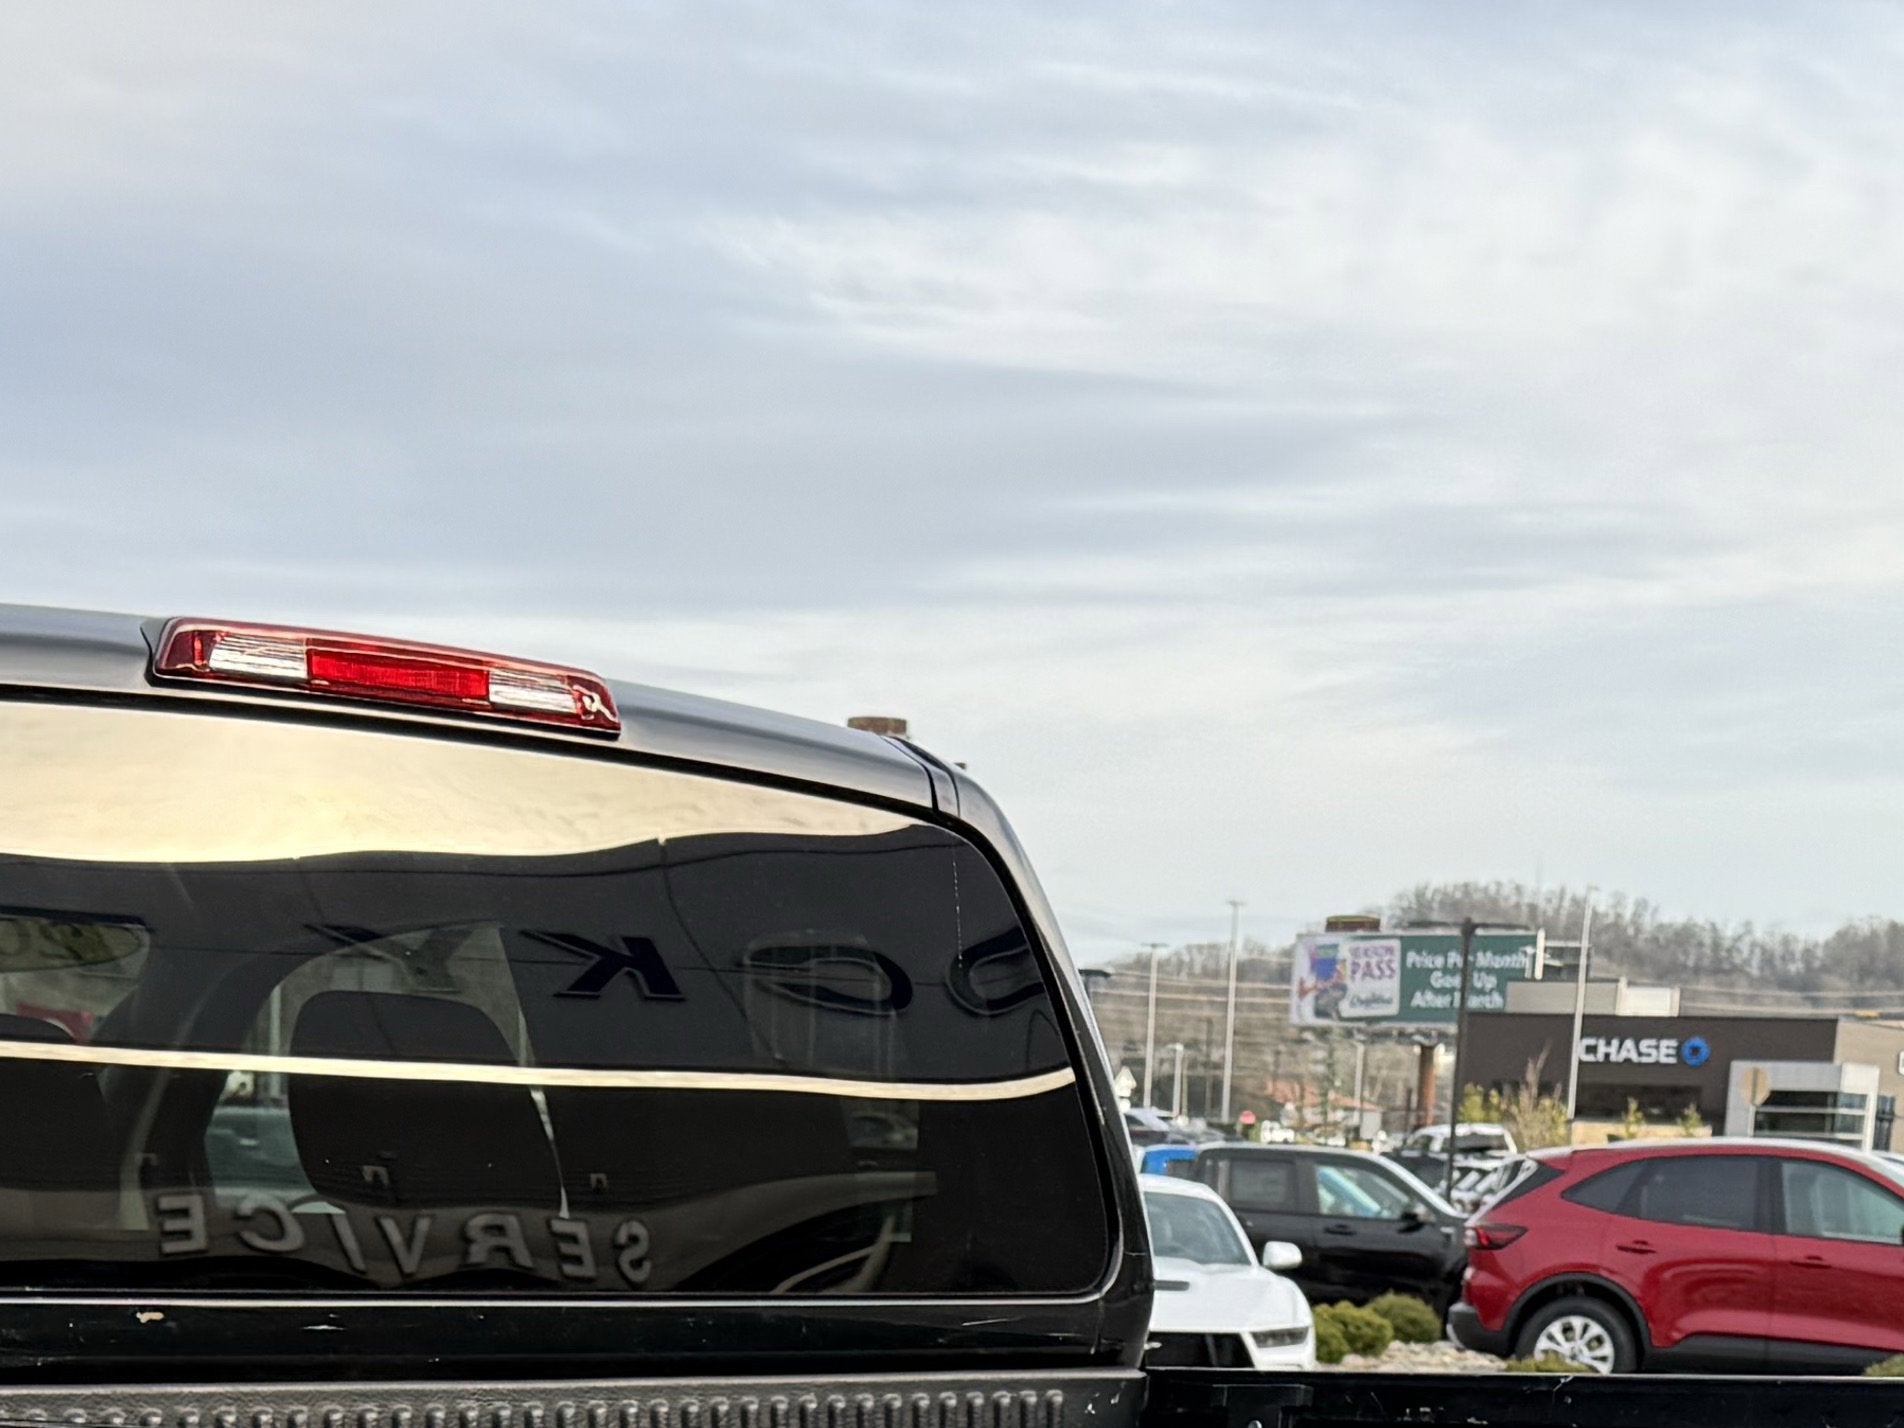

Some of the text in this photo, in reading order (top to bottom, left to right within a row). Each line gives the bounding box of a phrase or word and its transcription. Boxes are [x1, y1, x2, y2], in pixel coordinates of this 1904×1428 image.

[1350, 958, 1395, 982] PASS
[1406, 950, 1445, 968] Price
[1475, 950, 1527, 969] Month
[1472, 971, 1497, 992] Up
[1410, 990, 1452, 1008] After
[1578, 1036, 1679, 1064] CHASE
